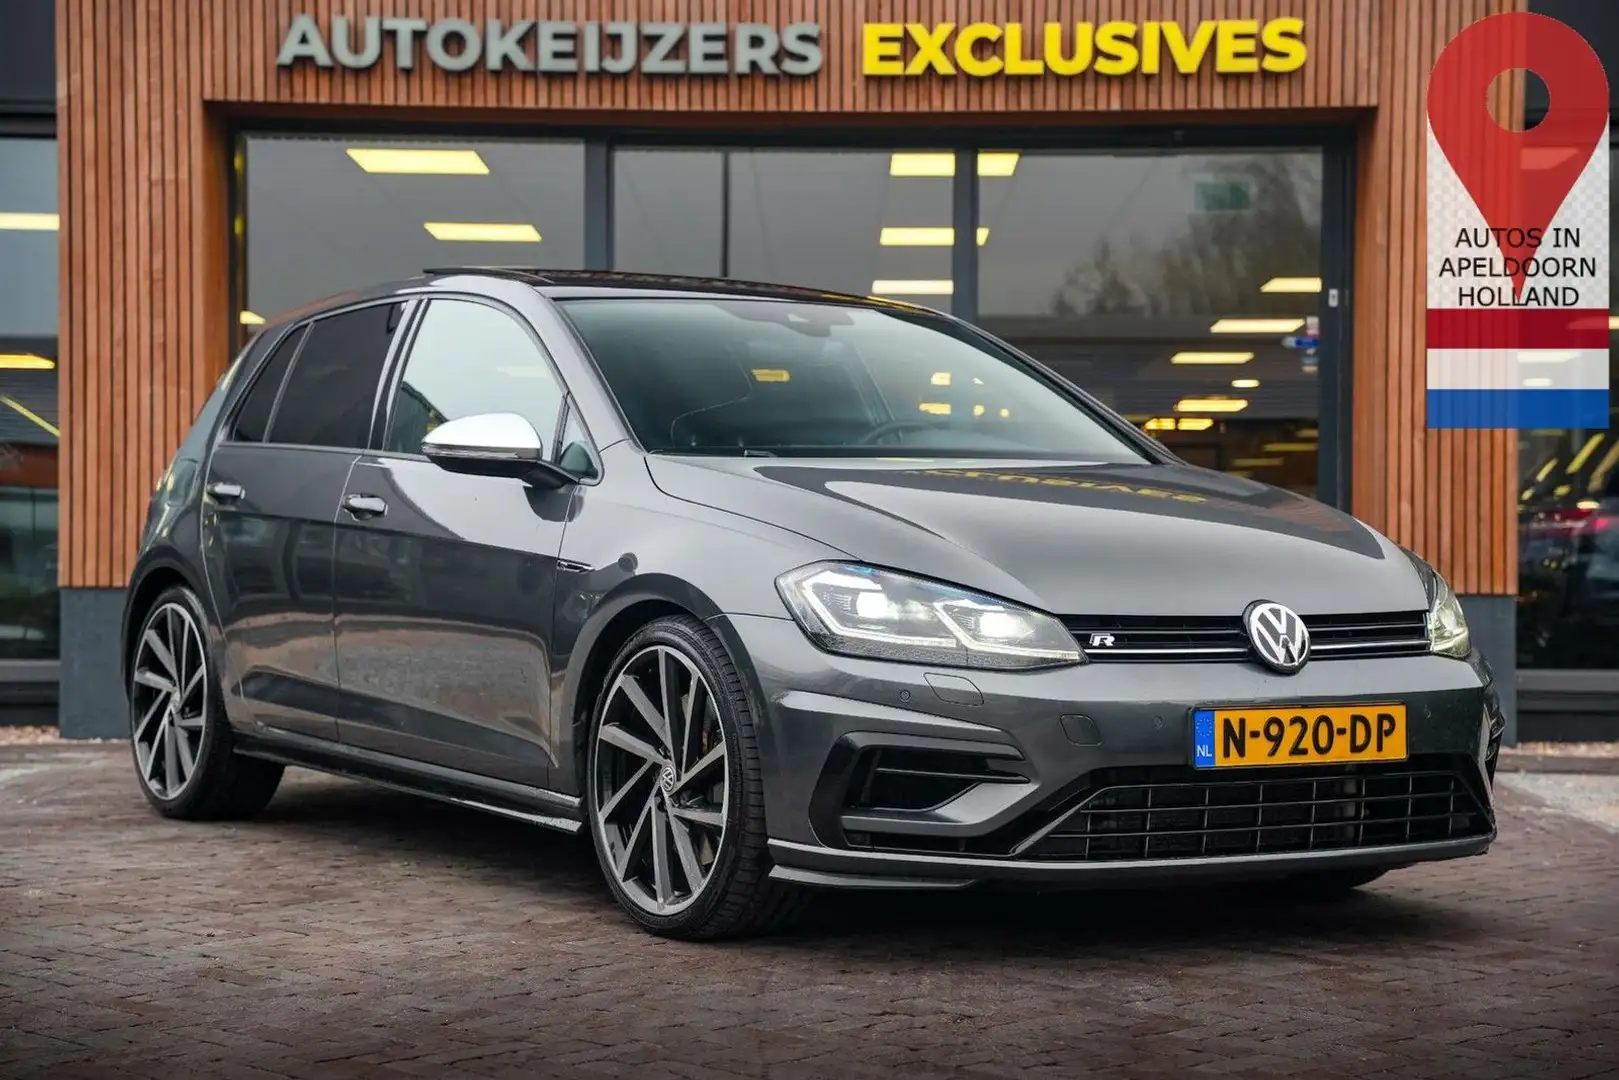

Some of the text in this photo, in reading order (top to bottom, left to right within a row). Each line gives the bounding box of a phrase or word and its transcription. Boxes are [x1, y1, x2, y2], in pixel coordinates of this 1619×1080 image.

[276, 14, 1308, 77] AUTOKEIJZERS EXCLUSIVES
[1089, 633, 1115, 647] R
[1196, 744, 1213, 758] NL
[1222, 713, 1397, 759] N-920-DP
